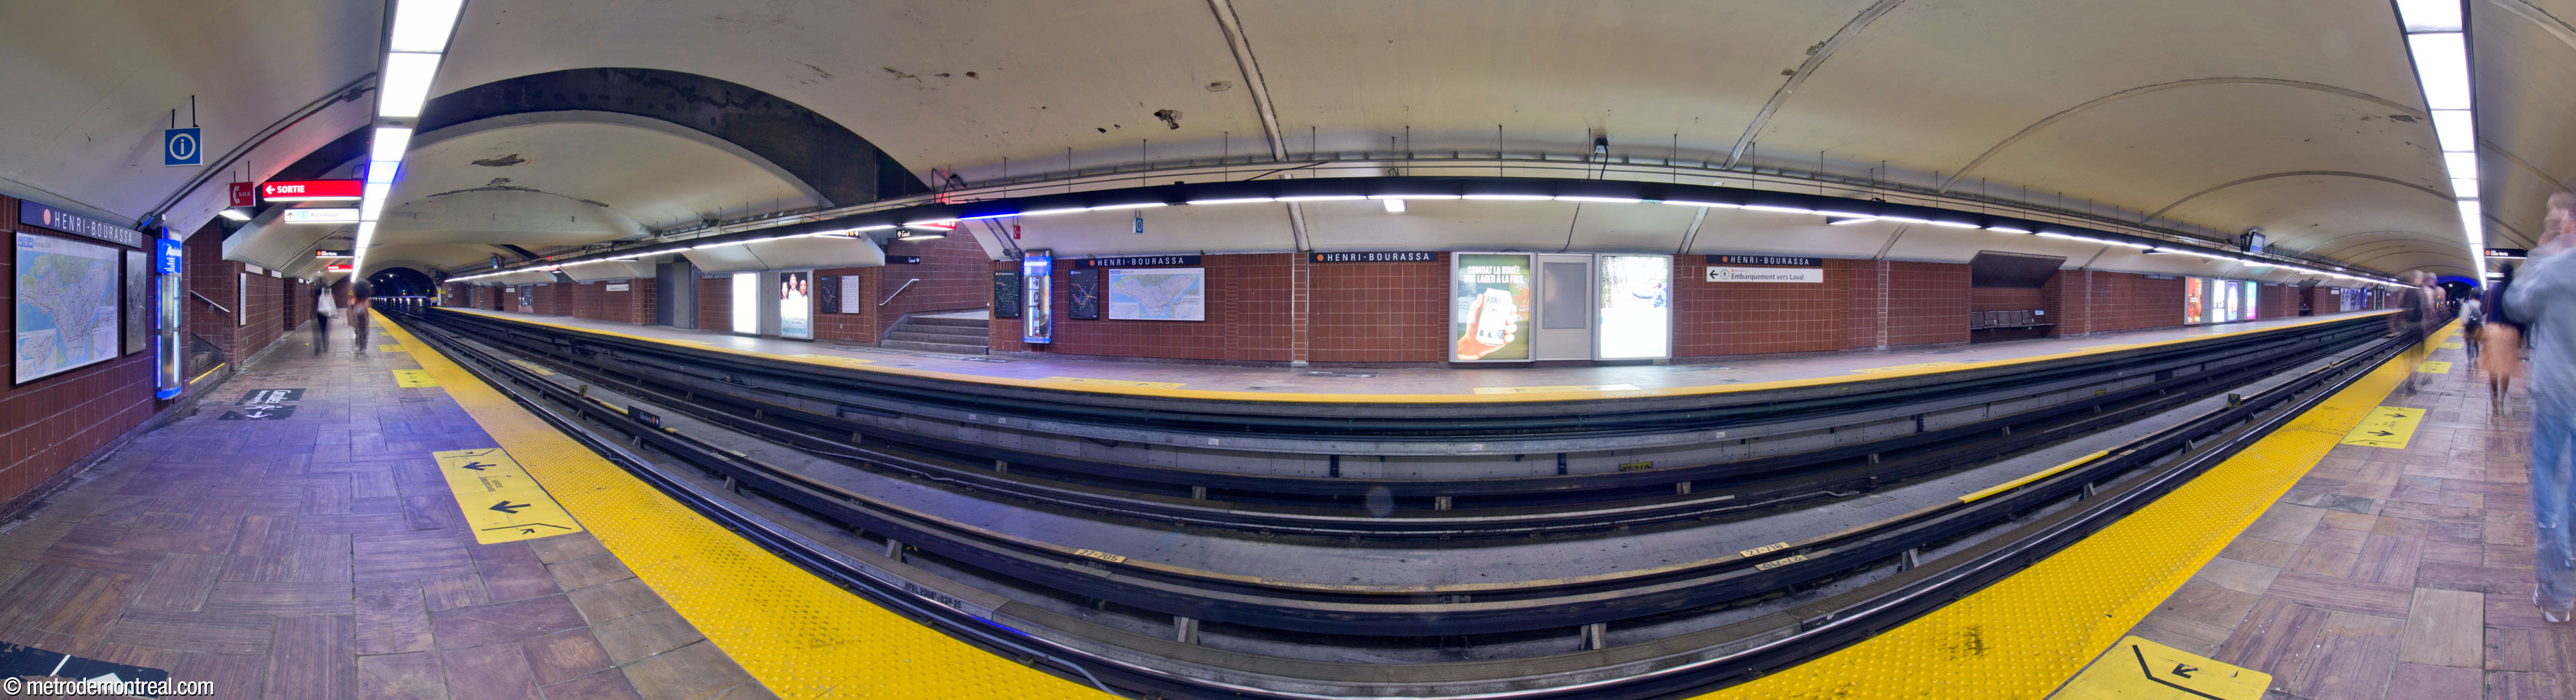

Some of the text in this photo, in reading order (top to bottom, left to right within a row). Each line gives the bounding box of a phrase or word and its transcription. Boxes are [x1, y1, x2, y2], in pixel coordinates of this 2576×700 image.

[276, 185, 305, 193] SORTIE
[54, 211, 133, 244] HENRI-BOURASSA
[1098, 256, 1184, 267] HENRI-BOURASSA
[1327, 253, 1429, 262] HENRI-BOURASSA
[1730, 255, 1809, 265] HENRI-BOURASSA
[1467, 265, 1492, 274] COMBAT
[1493, 265, 1501, 274] LA
[1464, 274, 1476, 283] UNE
[1477, 274, 1496, 283] LAGER
[1731, 273, 1775, 281] Embarquement
